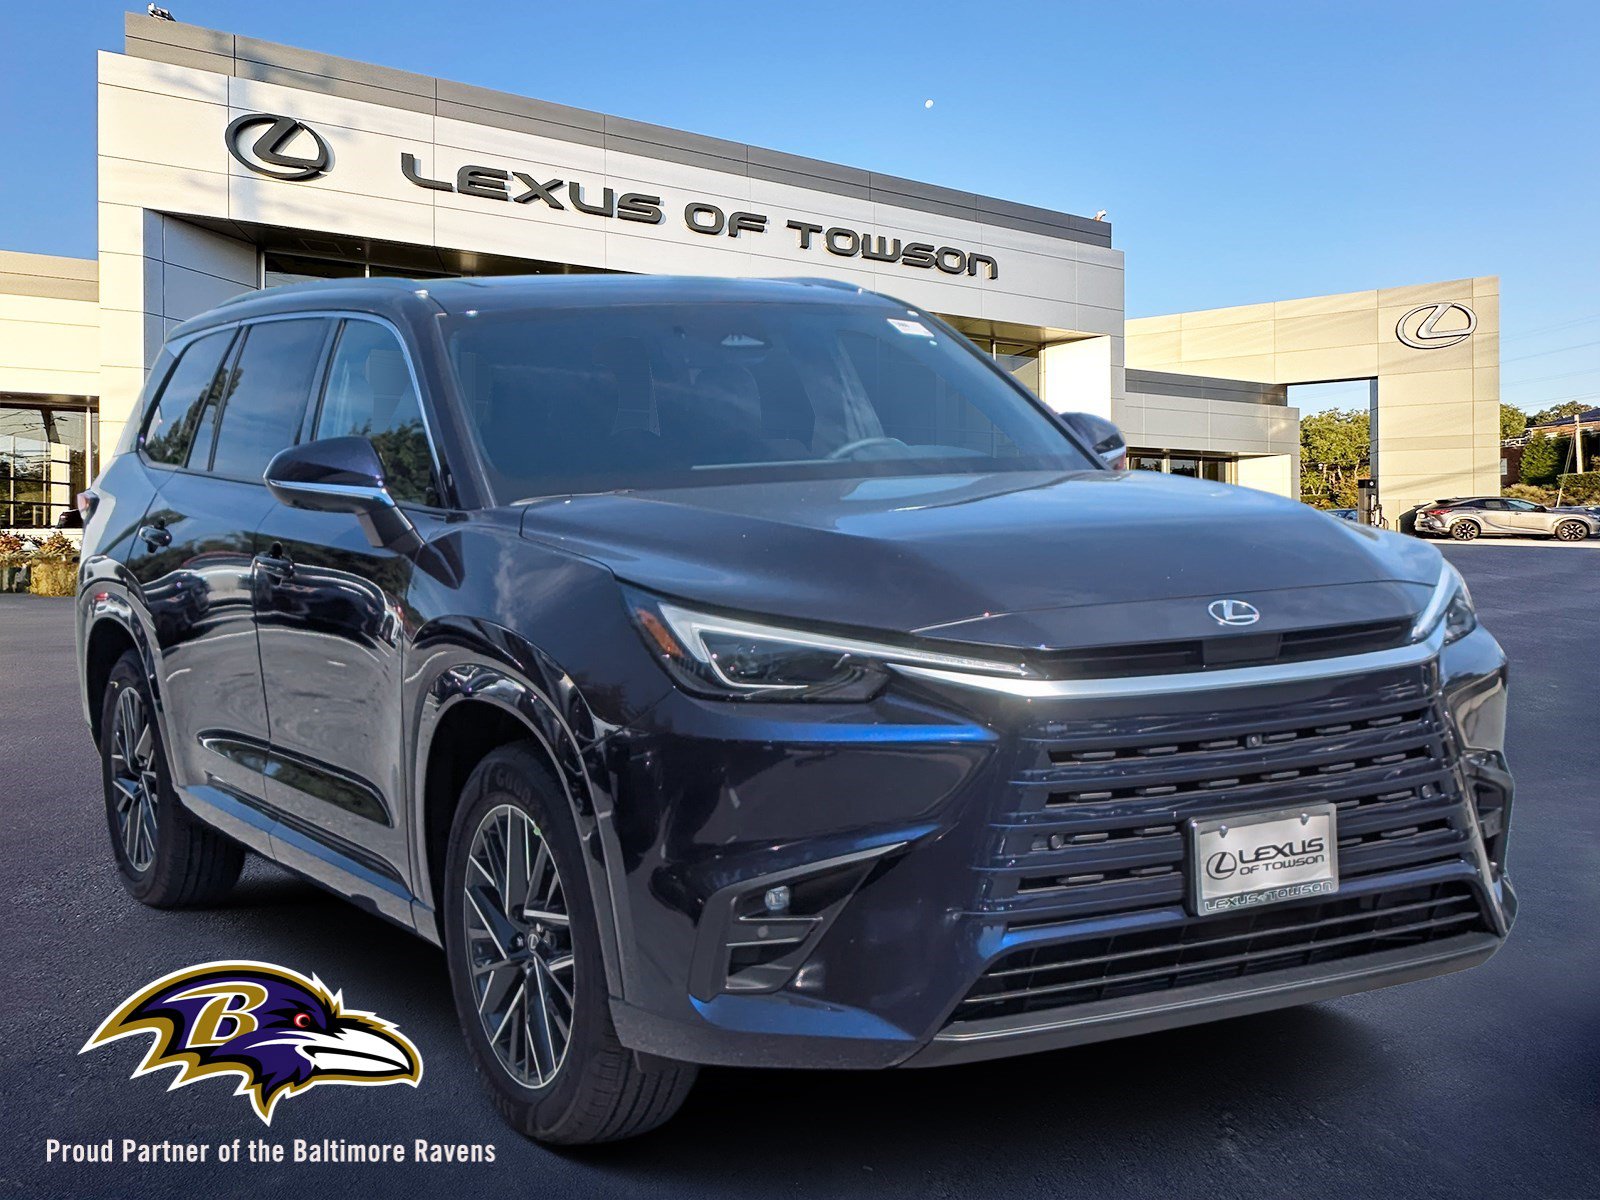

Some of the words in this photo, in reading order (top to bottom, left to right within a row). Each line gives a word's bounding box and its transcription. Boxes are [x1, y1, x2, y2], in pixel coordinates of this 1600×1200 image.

[401, 152, 663, 225] LEXUS
[684, 202, 768, 238] OF
[786, 219, 999, 280] TOWSON
[1239, 837, 1325, 864] LEXUS
[1239, 864, 1260, 876] OF
[1261, 854, 1325, 872] TOWSON
[1204, 891, 1257, 912] LEXUS
[1268, 881, 1333, 902] TOWSON
